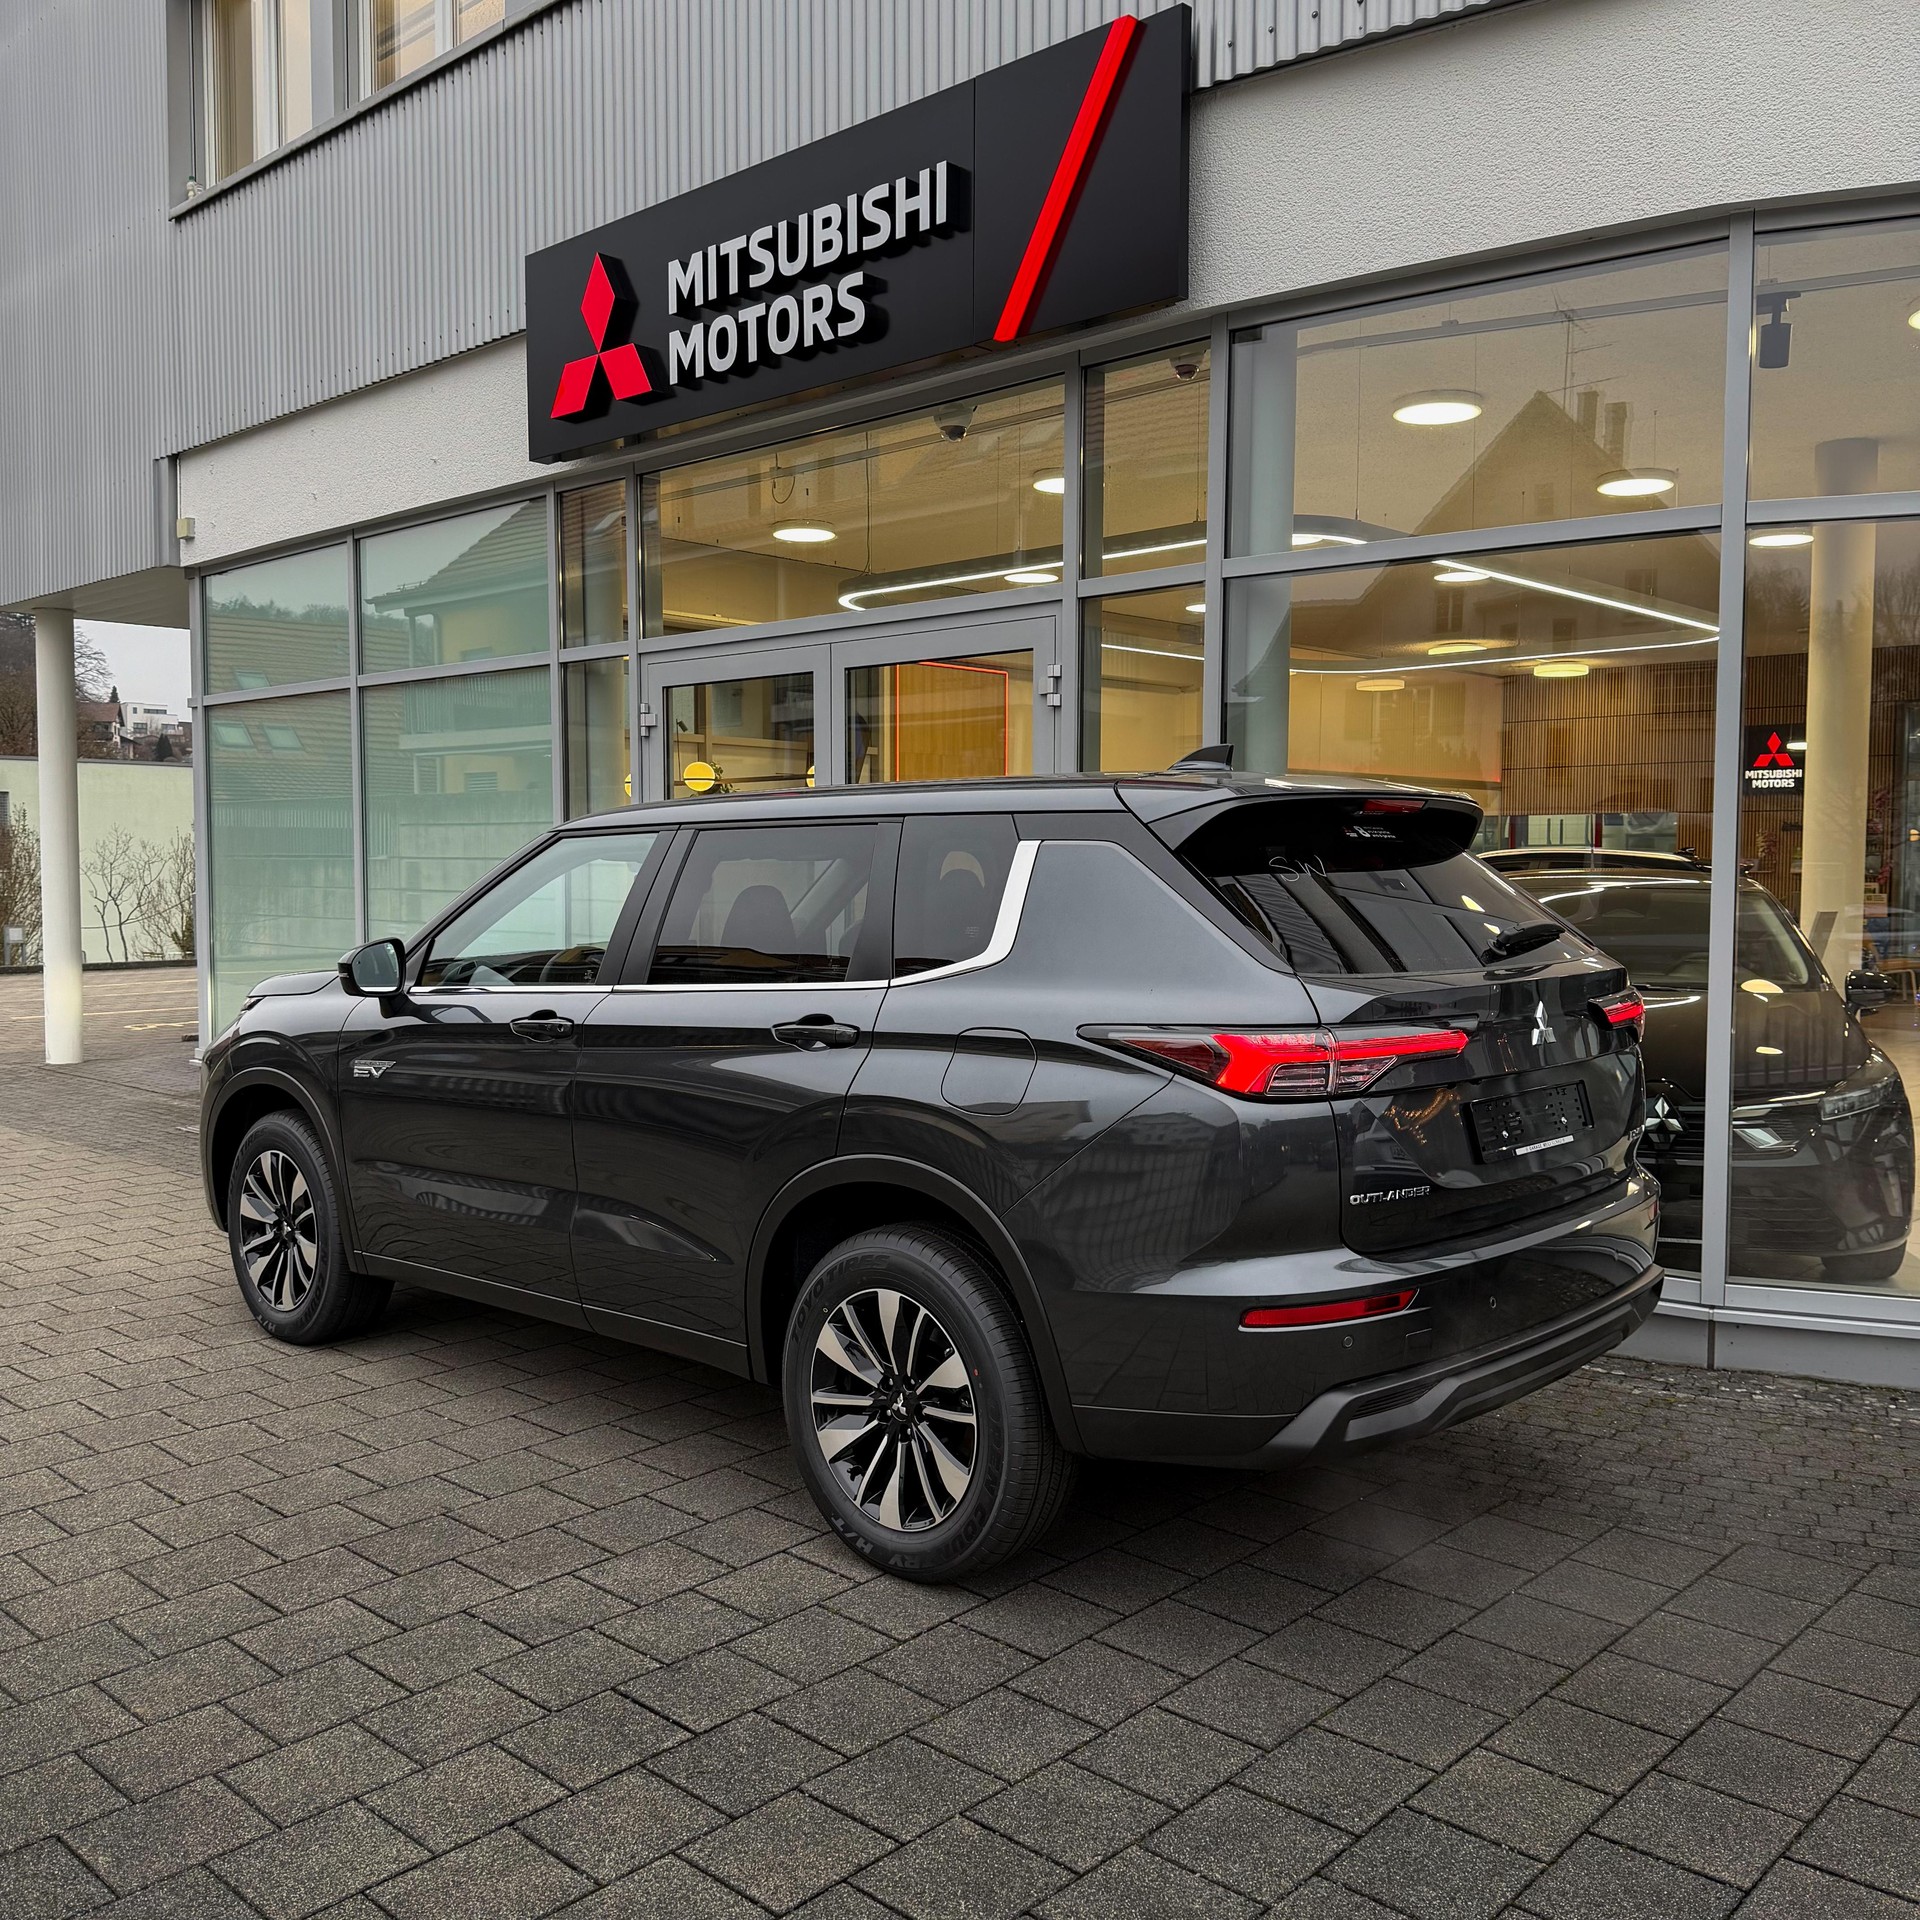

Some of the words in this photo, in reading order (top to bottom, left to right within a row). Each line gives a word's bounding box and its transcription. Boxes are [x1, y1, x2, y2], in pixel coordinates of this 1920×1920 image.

[667, 160, 948, 315] MITSUBISHI
[668, 272, 867, 386] MOTORS
[1745, 769, 1803, 779] MITSUBISHI
[1752, 779, 1795, 789] MOTORS
[1349, 1185, 1431, 1205] OUTLANDER
[791, 1278, 824, 1345] TOYO
[826, 1253, 891, 1283] TIRES
[831, 1513, 874, 1555] H/T
